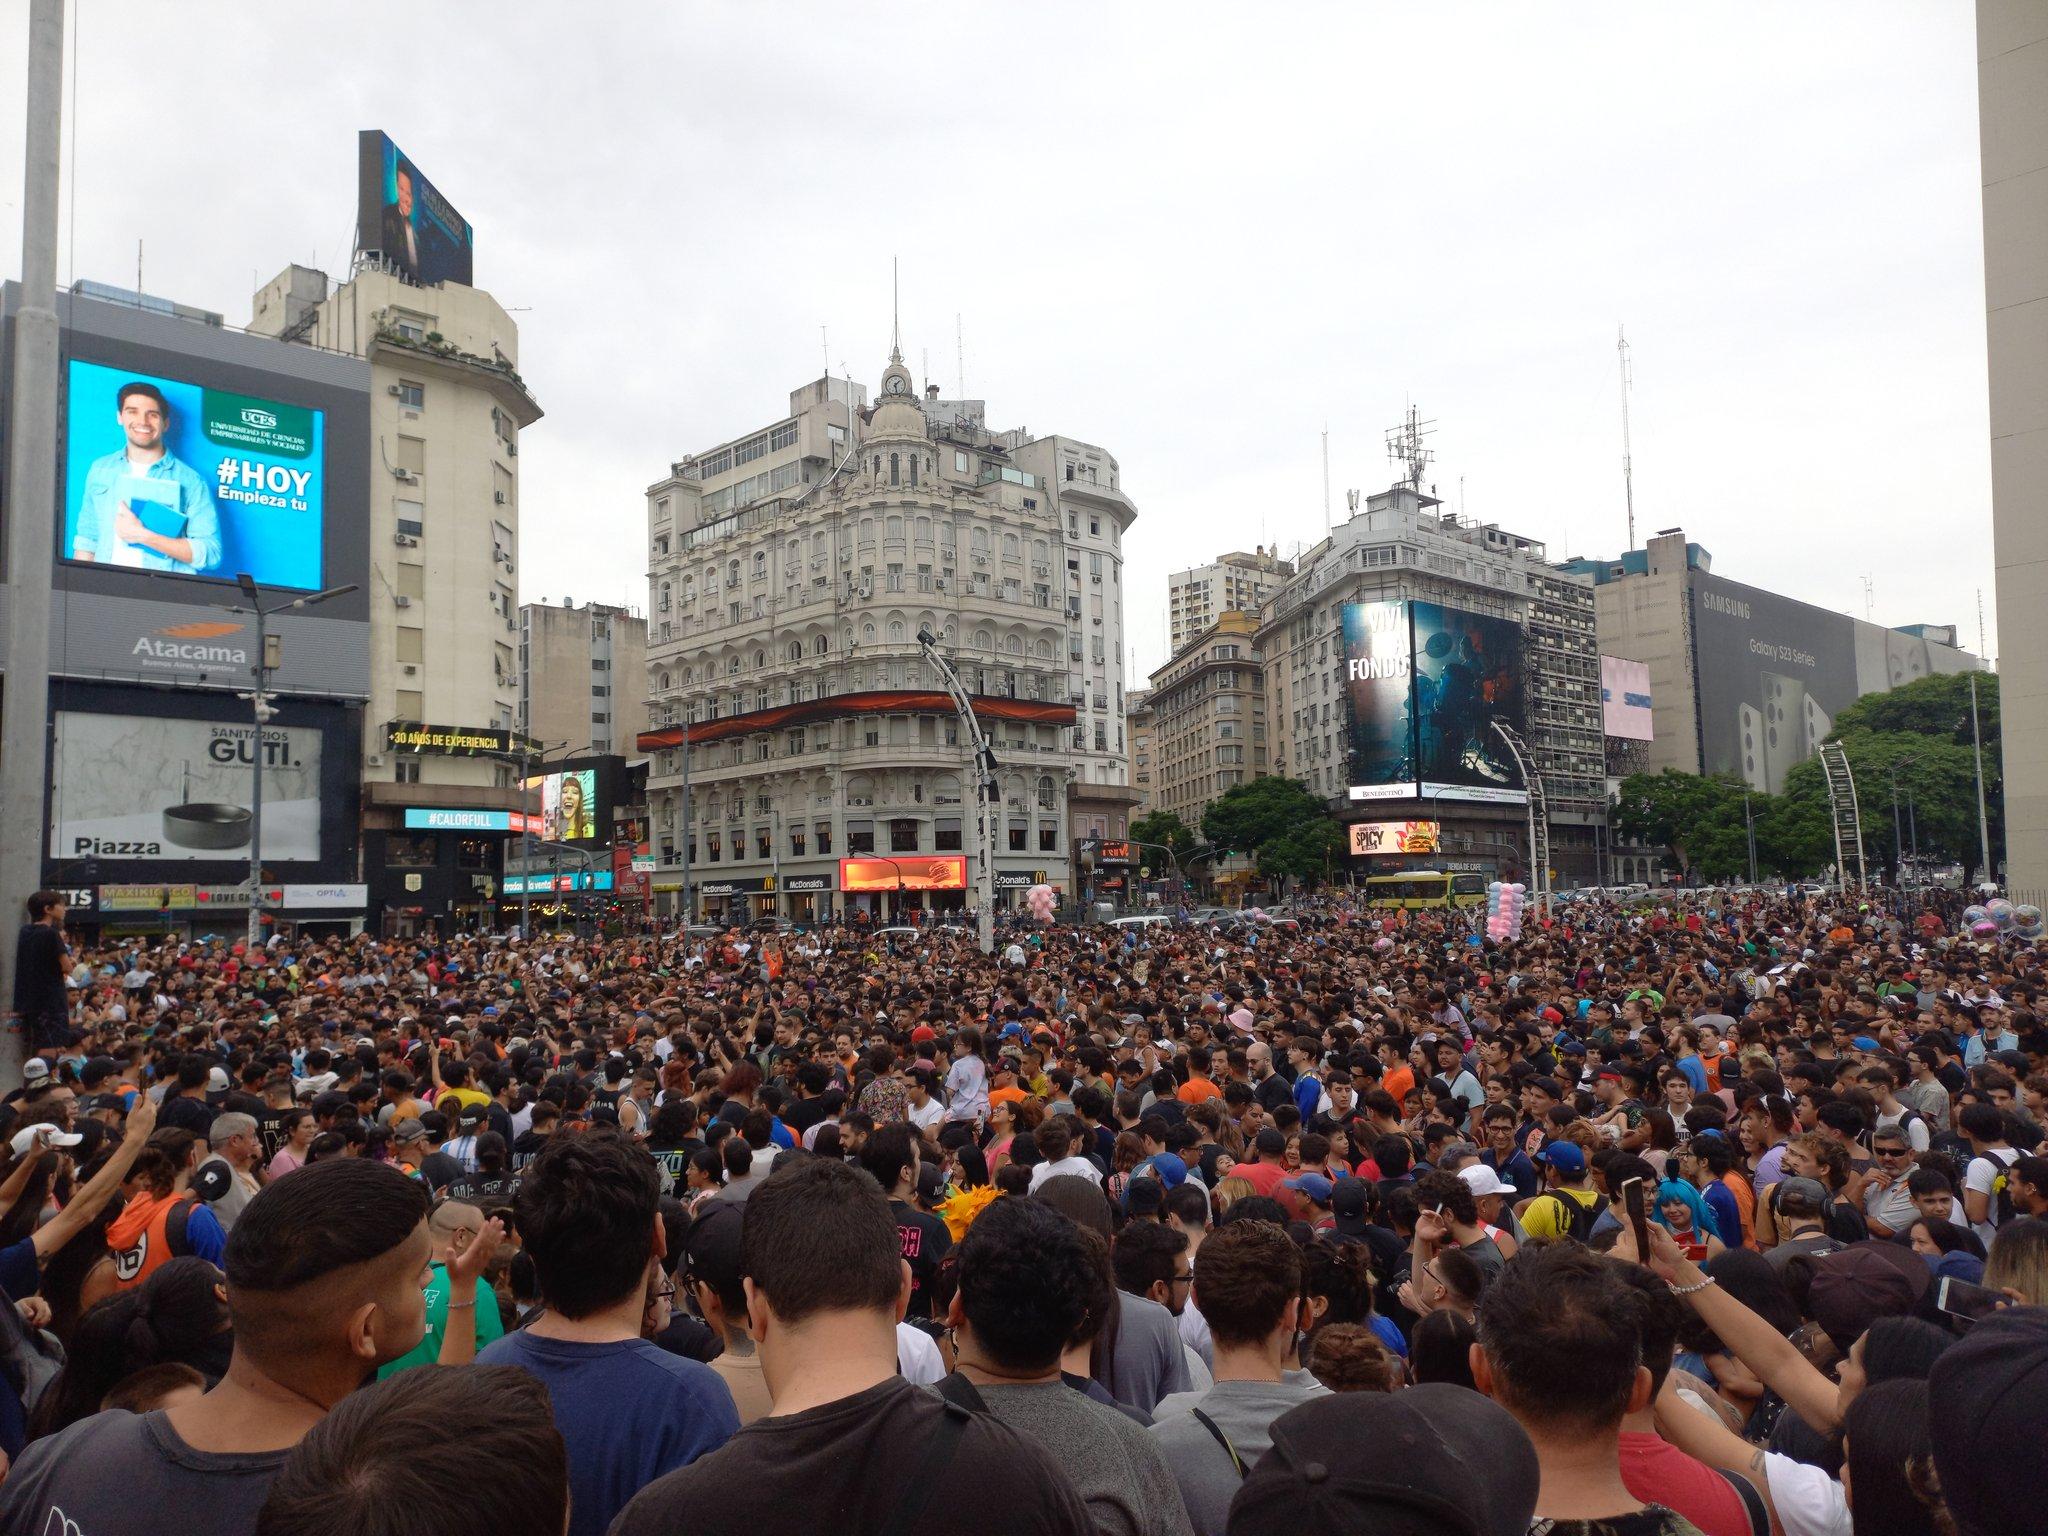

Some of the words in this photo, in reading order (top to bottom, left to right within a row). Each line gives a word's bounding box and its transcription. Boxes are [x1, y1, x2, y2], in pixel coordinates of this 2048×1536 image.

[240, 411, 277, 427] UCES
[210, 421, 260, 436] UNIVERSIDAD
[260, 430, 271, 439] DE
[272, 433, 305, 445] CIENCIAS
[210, 428, 266, 444] EMPRESARIALES
[271, 440, 305, 452] SOCIALES
[216, 457, 312, 497] #HOY
[218, 484, 287, 508] Empieza
[290, 497, 308, 512] tu
[1703, 591, 1751, 619] SAMSUNG
[132, 637, 246, 664] Atacama
[1749, 638, 1779, 662] Galaxy
[1779, 646, 1792, 661] S23
[1792, 649, 1816, 667] Series
[142, 659, 172, 667] Buenos
[198, 663, 236, 672] Argentina
[1349, 656, 1410, 681] FONDO
[408, 731, 431, 745] AÑOS
[432, 734, 444, 746] DE
[445, 735, 498, 749] EXPERIENCIA
[1362, 789, 1404, 798] BENEDICTINO
[428, 813, 492, 827] #CALORFULL
[74, 836, 161, 855] Piazza
[1356, 830, 1385, 850] SPICY
[702, 884, 733, 894] McDonald's
[789, 879, 824, 889] McDonald's
[995, 876, 1031, 885] cDonald's
[104, 886, 191, 897] MAXIKIOCO
[263, 1120, 280, 1130] THE
